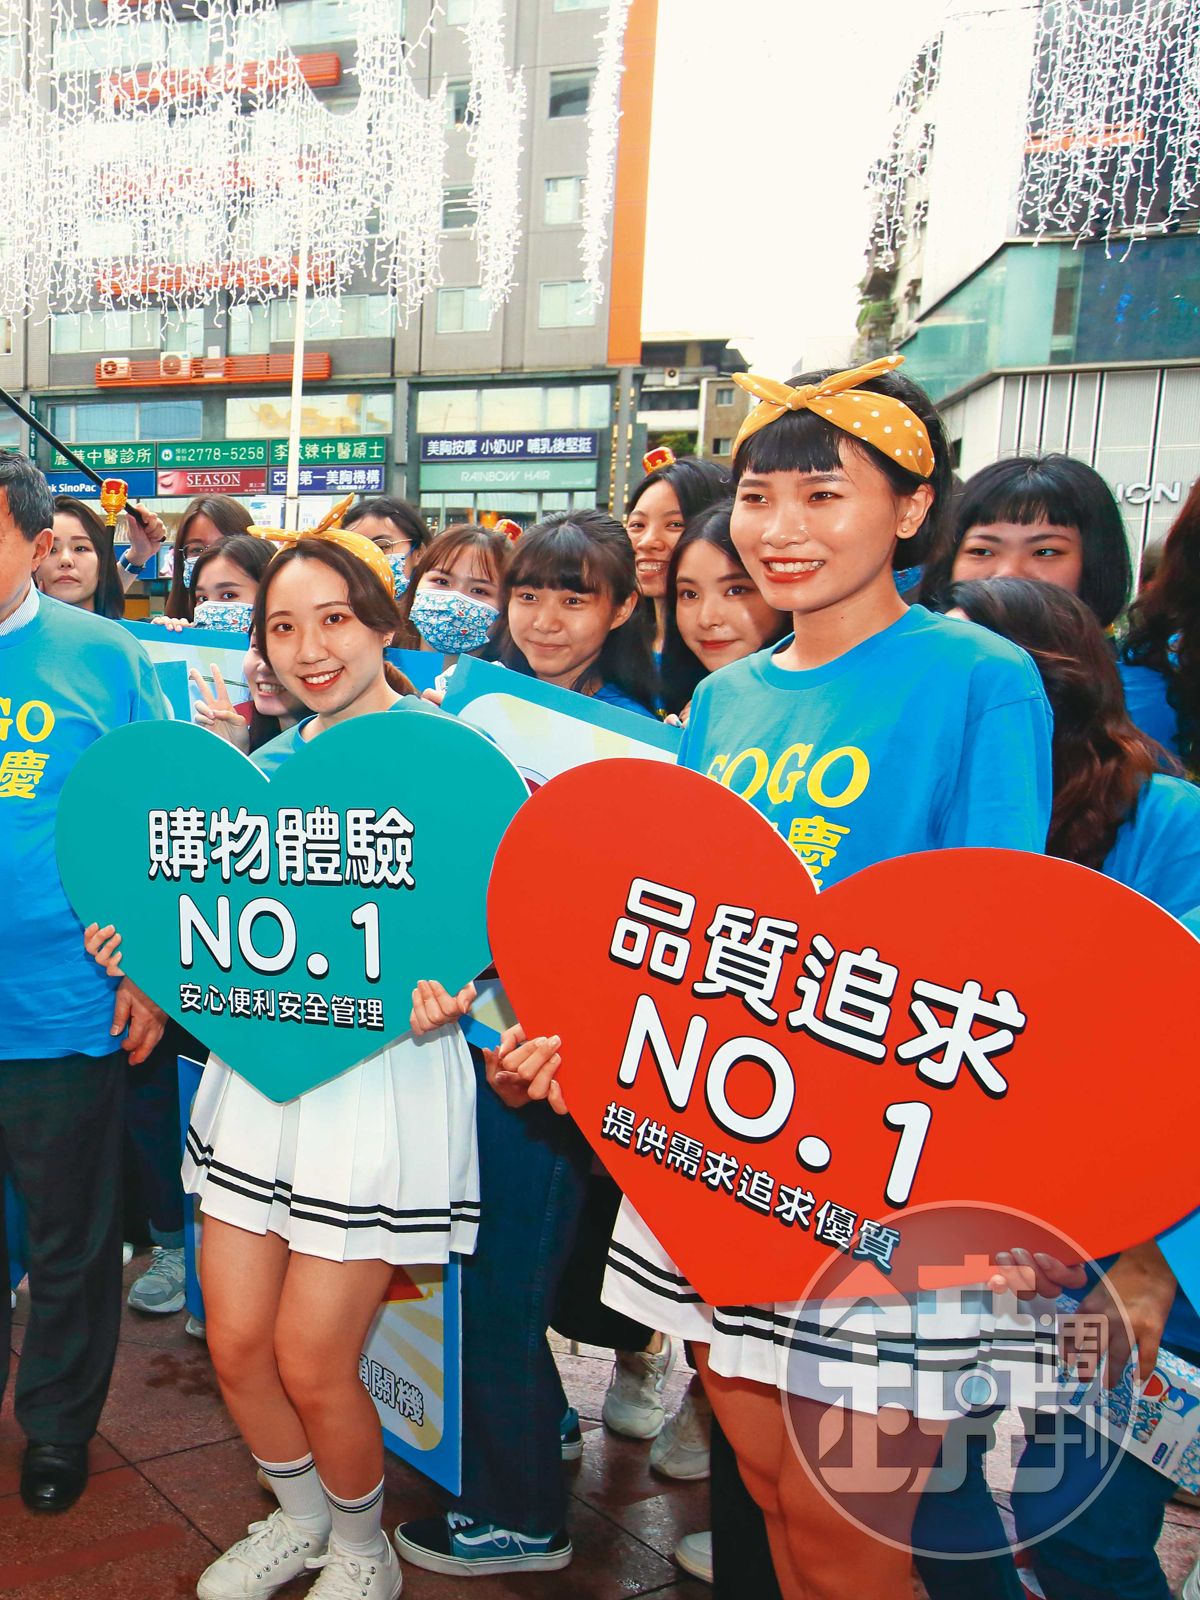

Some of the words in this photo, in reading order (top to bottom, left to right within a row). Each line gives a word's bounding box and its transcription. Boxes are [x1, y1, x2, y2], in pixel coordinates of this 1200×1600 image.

[188, 446, 264, 462] 2778-5258
[480, 439, 524, 455] 小奶UP
[186, 473, 241, 486] SEASON
[272, 469, 380, 486] 亞第一美胸機構
[460, 471, 519, 482] RAINBOW
[524, 470, 551, 481] HAIR
[59, 484, 97, 492] SinoPac
[147, 806, 416, 889] 購物體驗
[608, 876, 1028, 1096] 品質追求
[179, 982, 385, 1029] 安心便利安全管理
[601, 1101, 902, 1274] 提供需求追求優質
